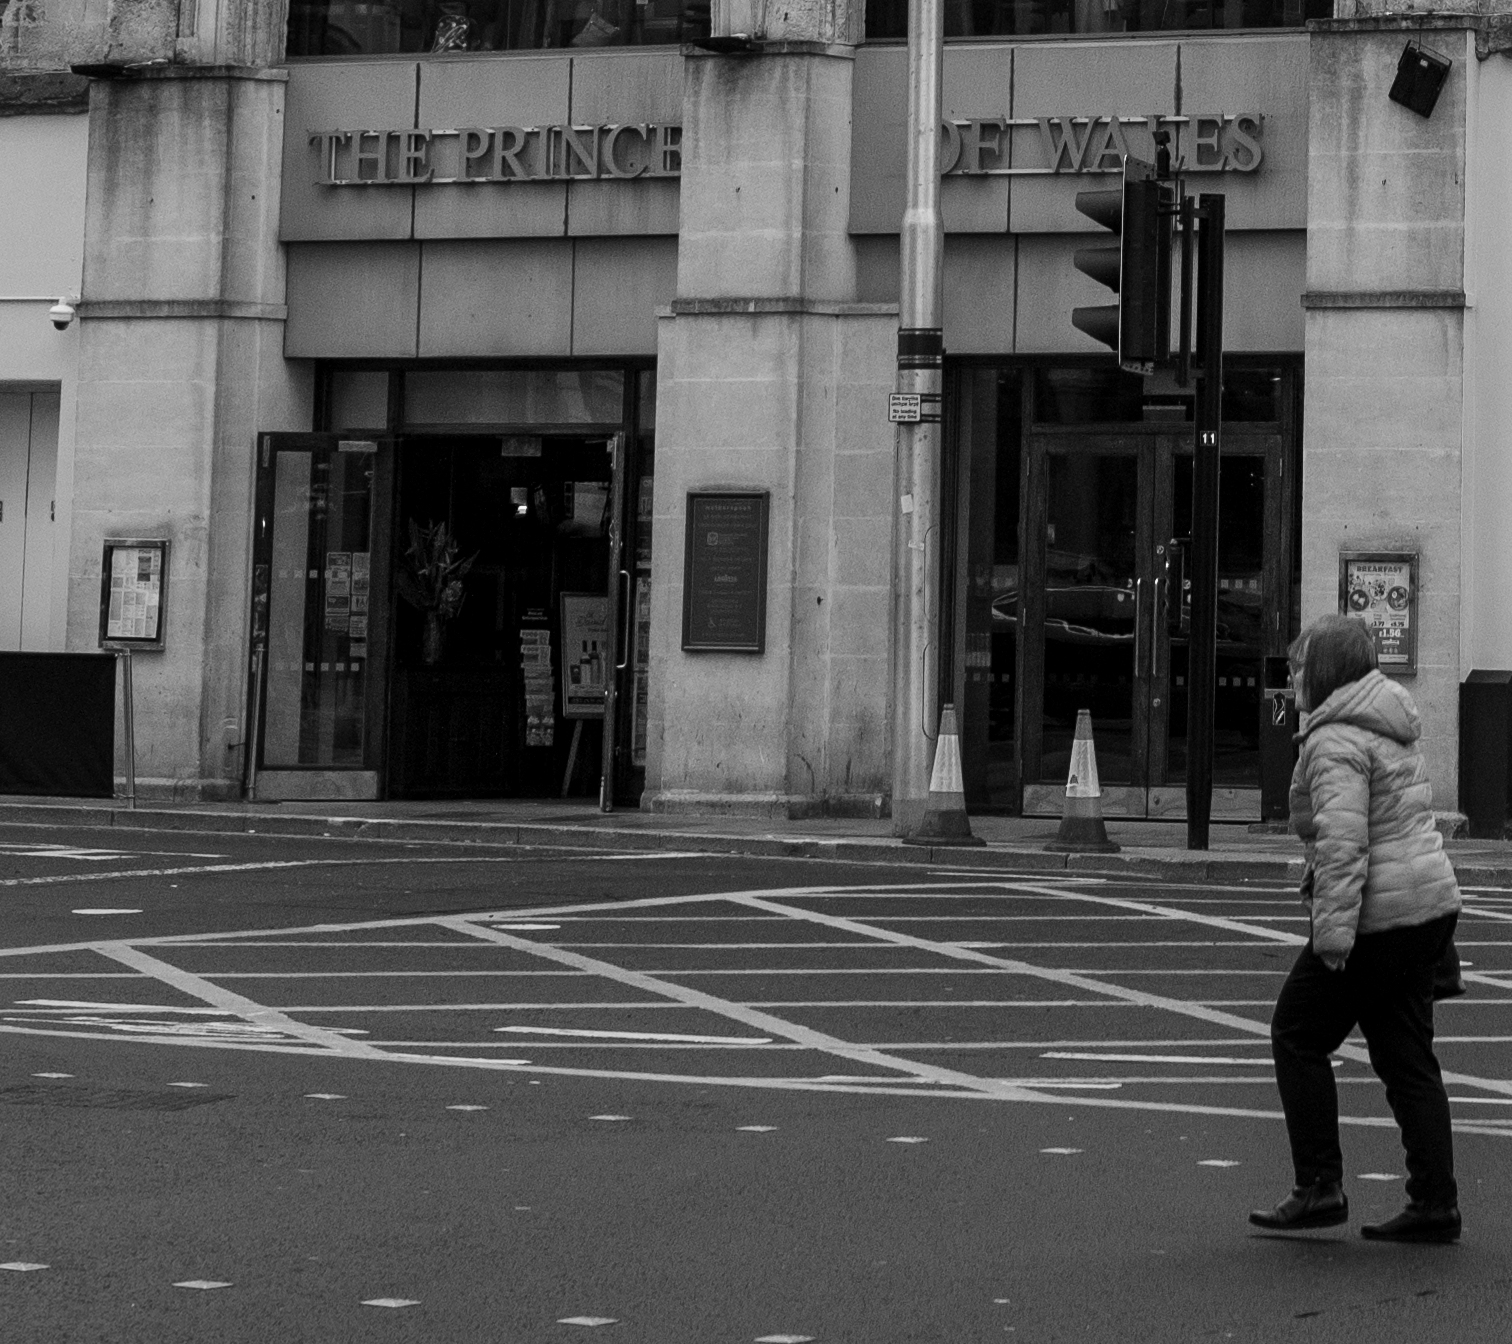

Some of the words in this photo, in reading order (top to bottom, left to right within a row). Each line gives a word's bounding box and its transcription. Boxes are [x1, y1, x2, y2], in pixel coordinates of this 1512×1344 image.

[308, 128, 435, 186] THE
[454, 123, 683, 182] PRINCE
[1033, 113, 1263, 174] WALES
[1202, 433, 1215, 444] 11
